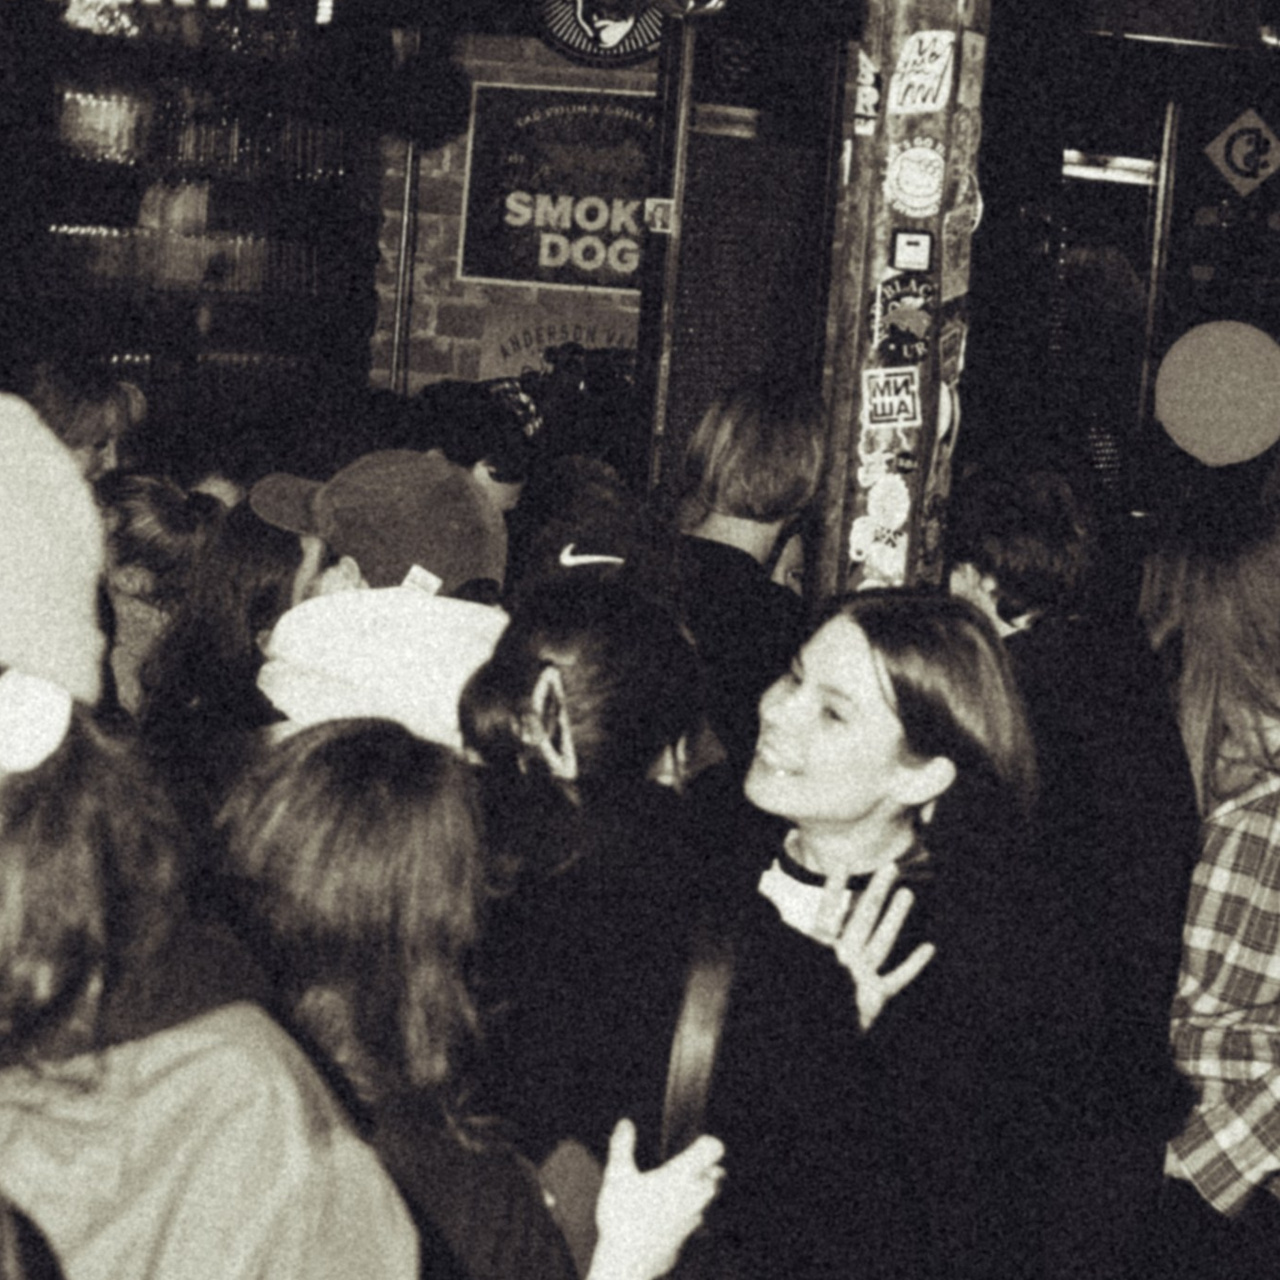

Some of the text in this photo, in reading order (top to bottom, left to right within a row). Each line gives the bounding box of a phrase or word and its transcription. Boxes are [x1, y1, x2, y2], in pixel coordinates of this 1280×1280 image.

[505, 190, 641, 235] SMOK
[538, 232, 640, 272] DOG
[873, 379, 910, 399] МИ
[873, 401, 911, 418] ША
